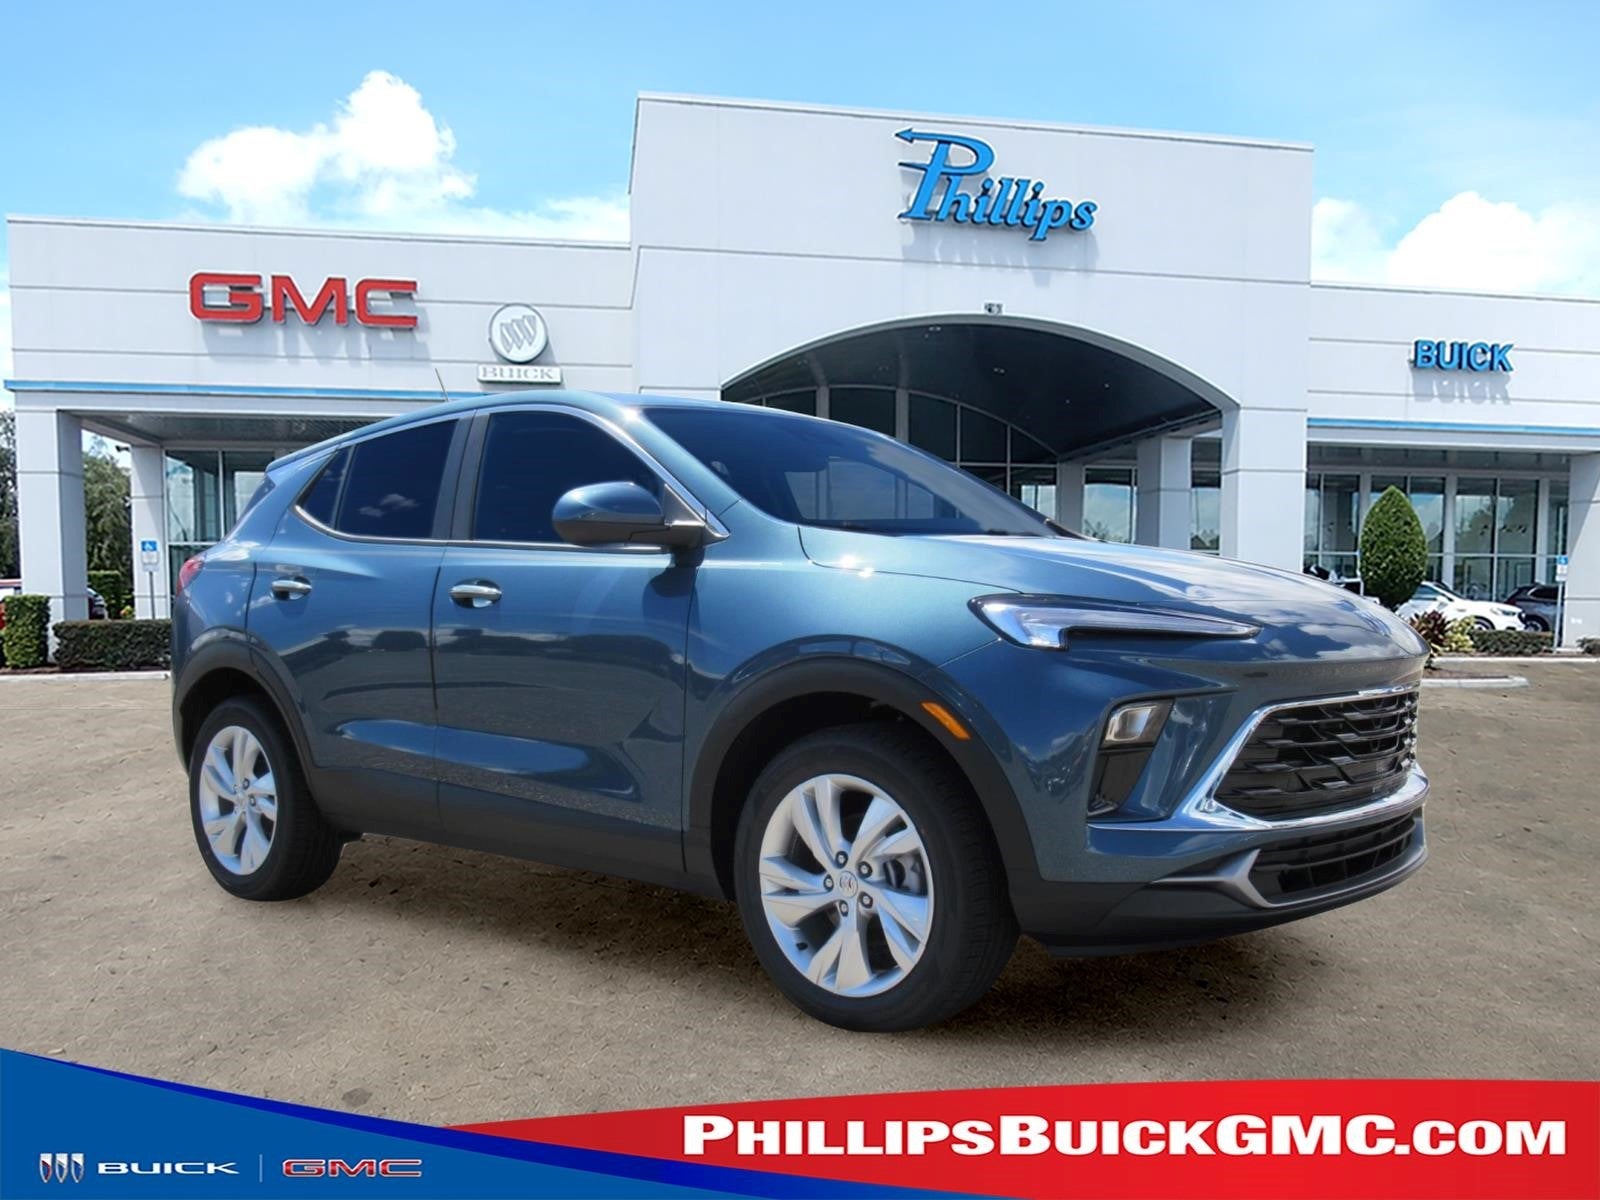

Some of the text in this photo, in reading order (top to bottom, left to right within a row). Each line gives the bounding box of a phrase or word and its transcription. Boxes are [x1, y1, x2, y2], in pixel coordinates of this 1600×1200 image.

[895, 127, 1098, 242] Phillips
[190, 271, 418, 330] GMC
[482, 367, 554, 380] BUICK
[1414, 340, 1514, 372] BUICK
